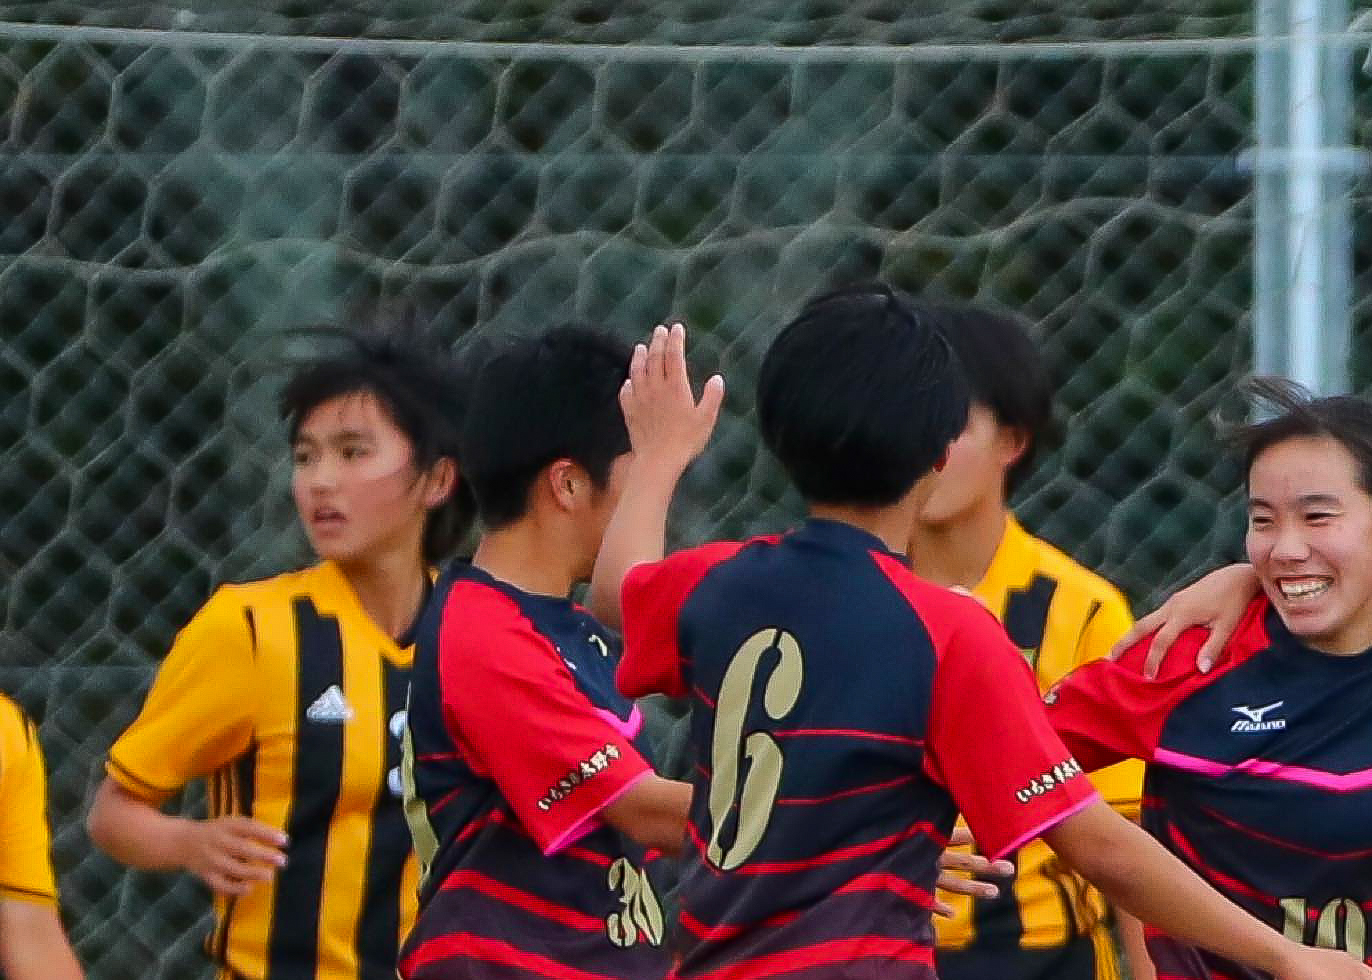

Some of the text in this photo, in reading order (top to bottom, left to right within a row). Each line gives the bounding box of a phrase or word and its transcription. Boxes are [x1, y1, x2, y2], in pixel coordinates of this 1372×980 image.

[707, 628, 803, 871] 6
[605, 857, 666, 948] 30
[1279, 897, 1367, 964] 10
